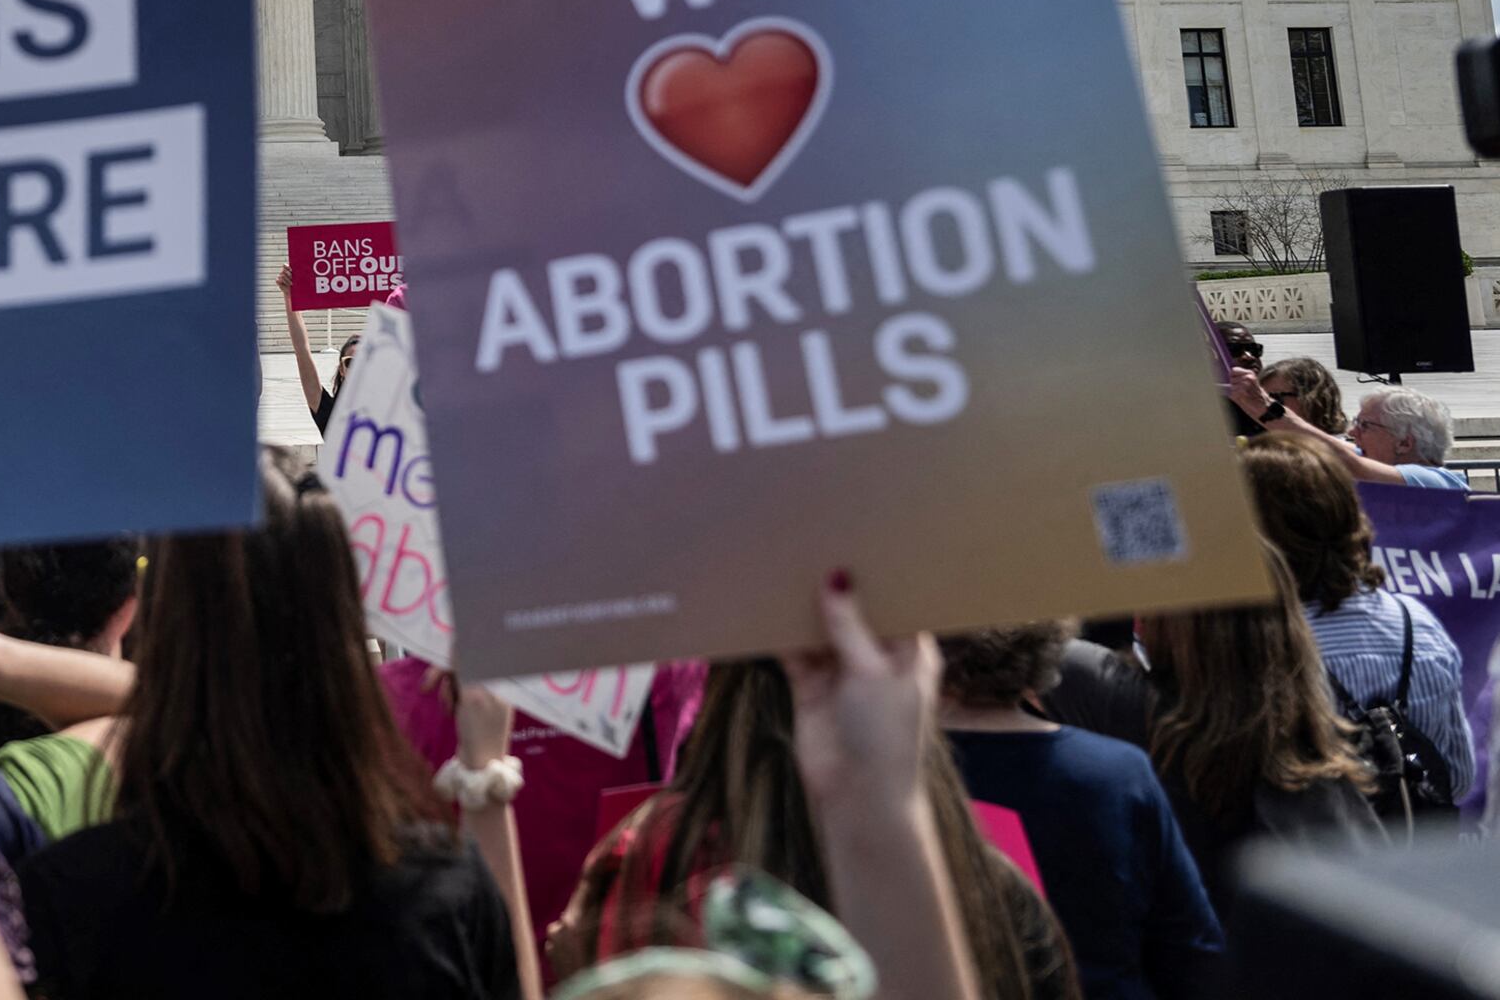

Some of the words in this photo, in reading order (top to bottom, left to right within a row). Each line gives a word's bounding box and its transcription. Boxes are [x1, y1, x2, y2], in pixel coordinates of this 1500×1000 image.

[313, 238, 373, 258] BANS
[313, 258, 356, 276] OFF
[475, 166, 1098, 374] ABORTION
[315, 273, 404, 294] BODIES
[615, 313, 972, 467] PILLS
